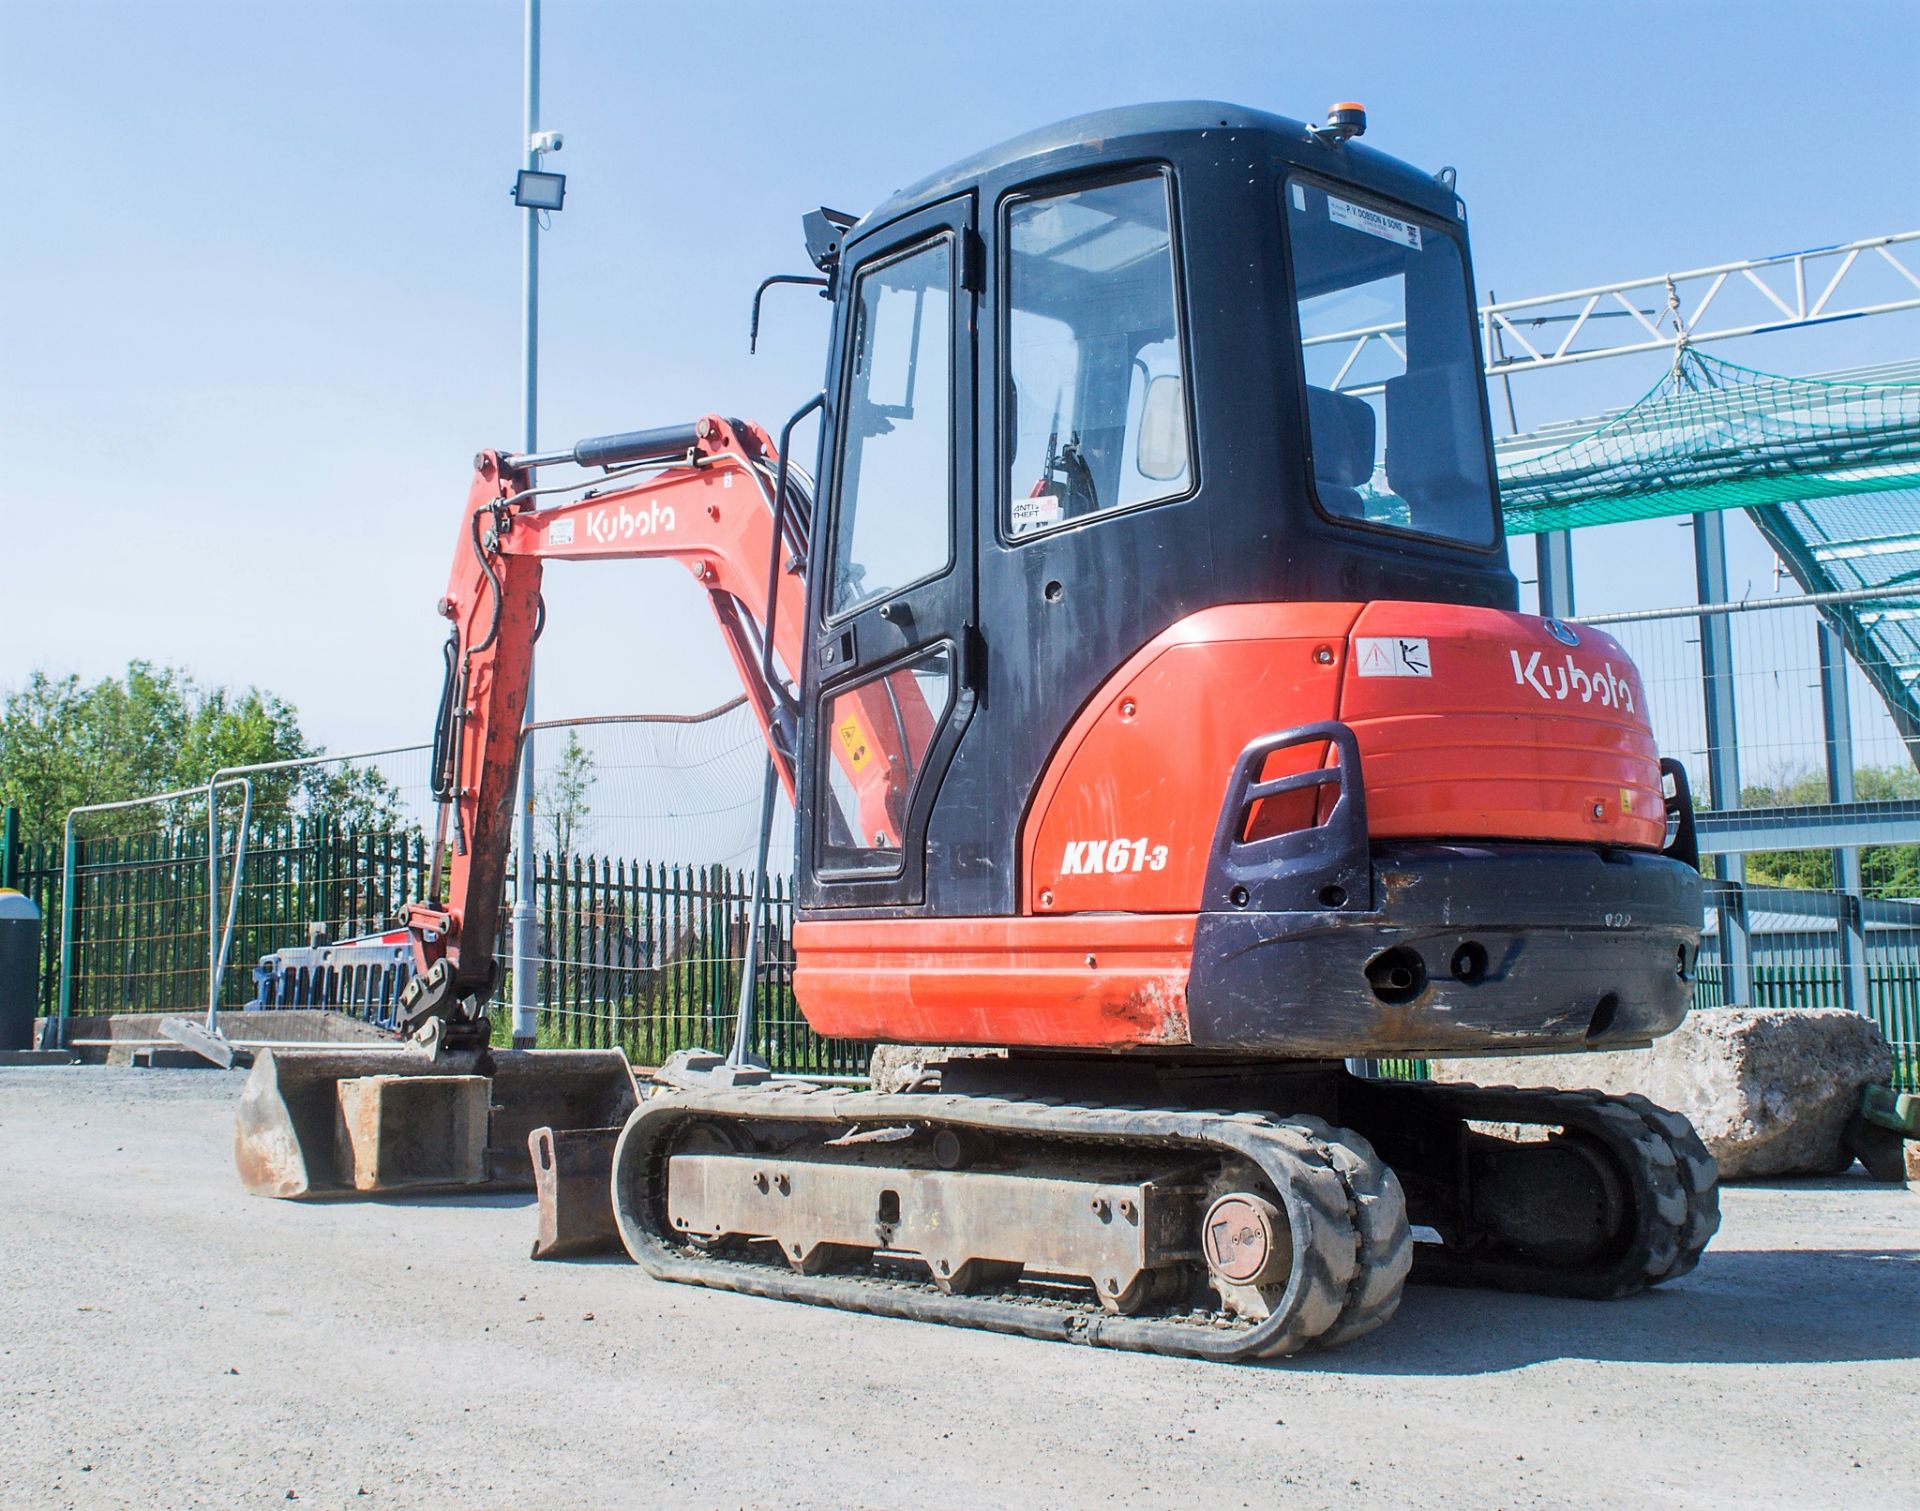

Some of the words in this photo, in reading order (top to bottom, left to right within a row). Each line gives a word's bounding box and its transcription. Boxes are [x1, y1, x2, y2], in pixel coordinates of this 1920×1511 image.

[1358, 208, 1382, 225] DOBSON
[1388, 220, 1403, 232] SONS
[586, 500, 676, 543] Kubota
[1012, 510, 1039, 519] THEFT
[1510, 650, 1635, 714] Kubota
[1060, 837, 1169, 875] KX61-3
